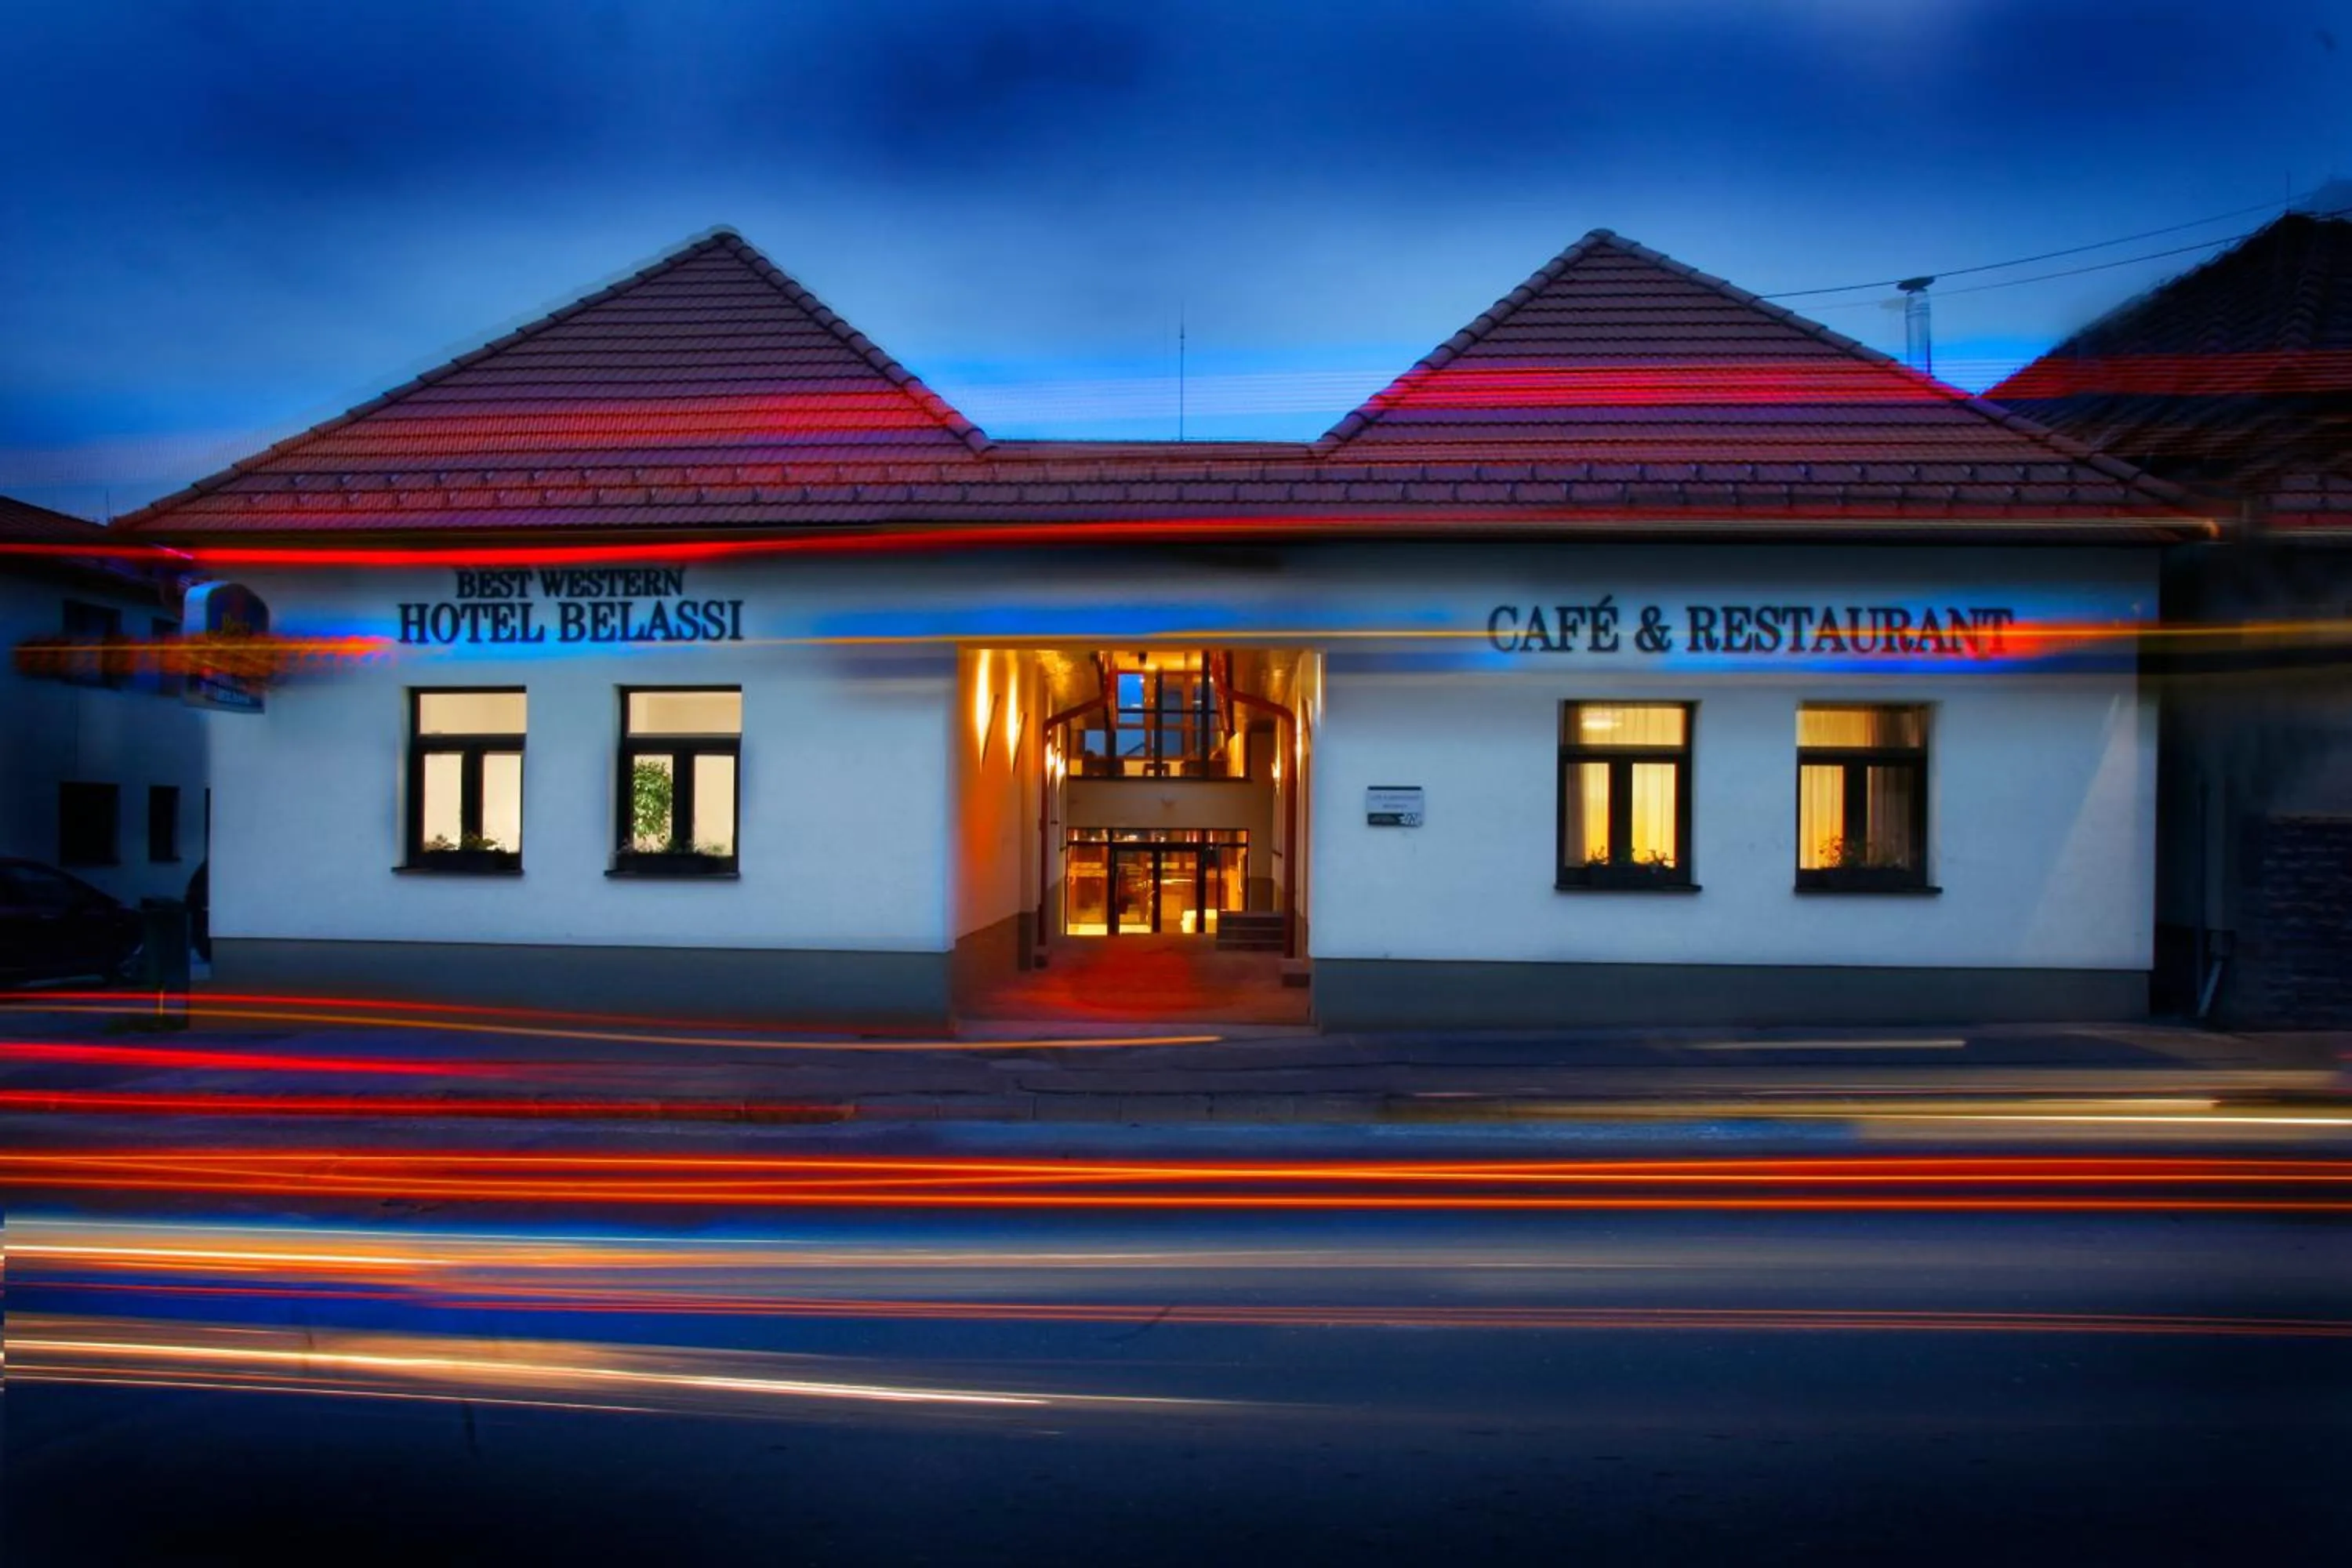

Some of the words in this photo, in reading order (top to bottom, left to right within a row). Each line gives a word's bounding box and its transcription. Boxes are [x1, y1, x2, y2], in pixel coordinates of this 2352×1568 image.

[456, 569, 533, 598] BEST
[539, 568, 684, 597] WESTERN
[398, 602, 545, 644] HOTEL
[557, 599, 745, 641] BELASSI
[1488, 594, 1620, 652] CAFÉ
[1634, 604, 1672, 653] &
[1686, 605, 2013, 655] RESTAURANT
